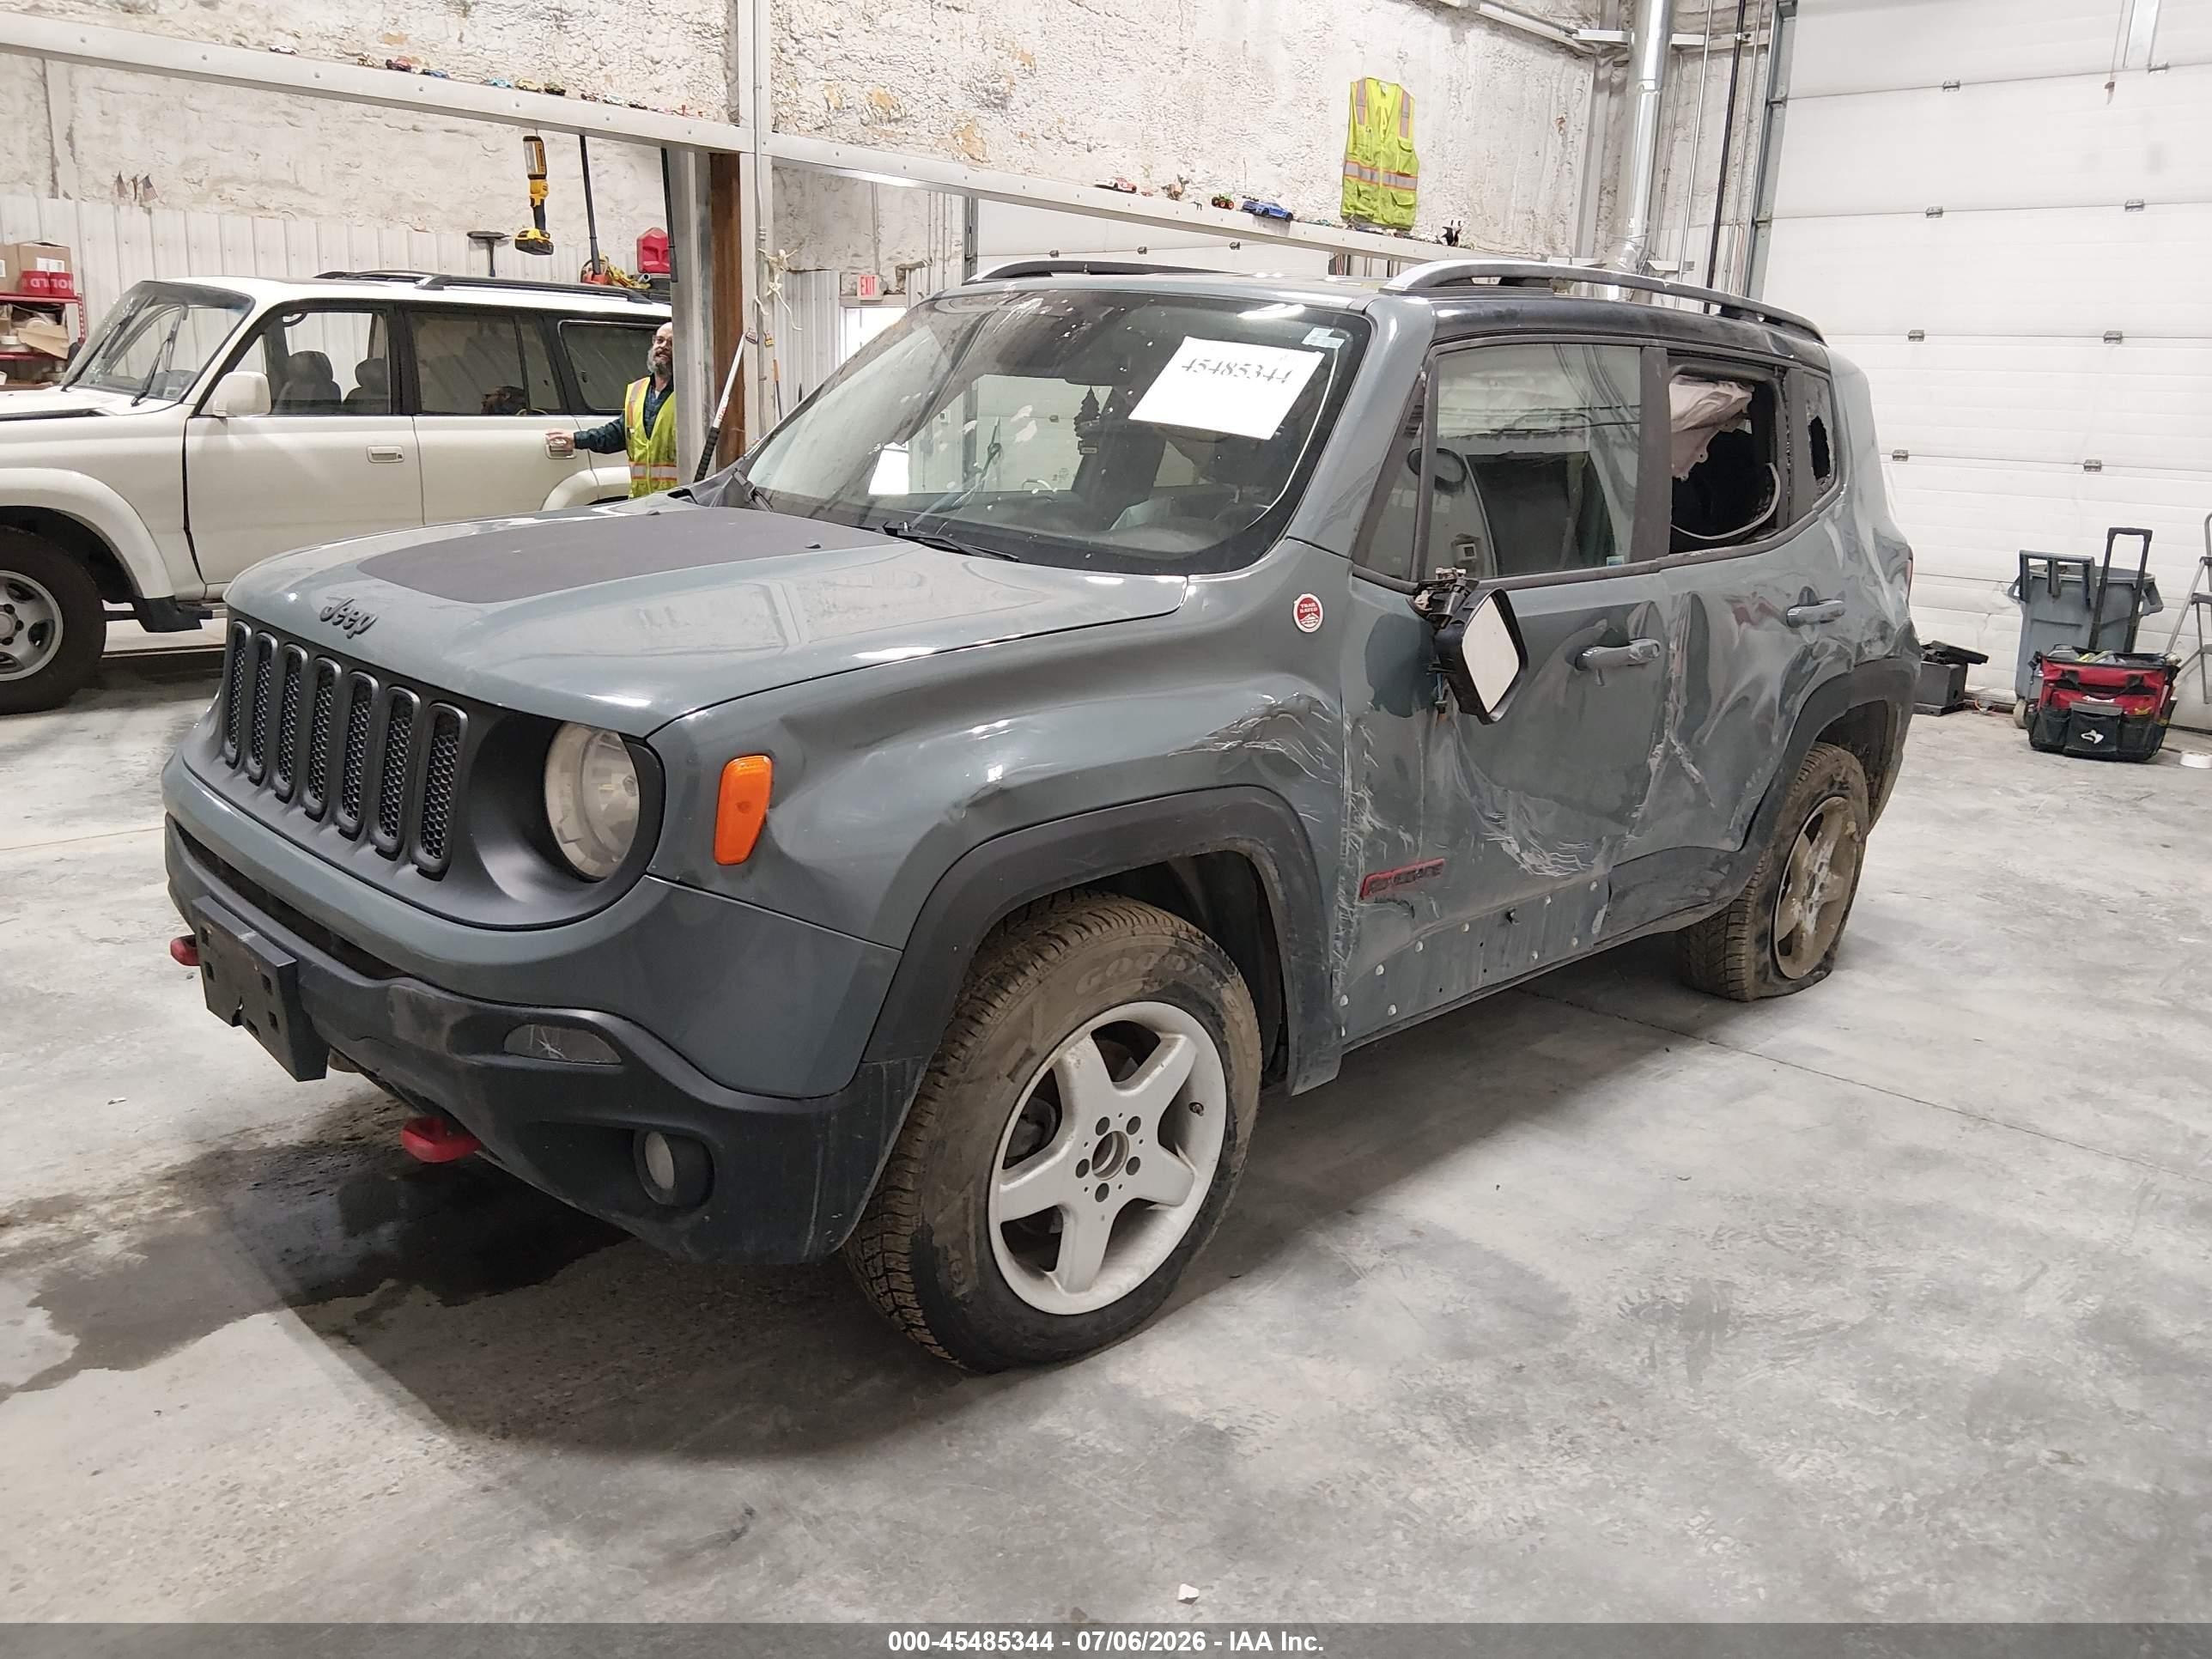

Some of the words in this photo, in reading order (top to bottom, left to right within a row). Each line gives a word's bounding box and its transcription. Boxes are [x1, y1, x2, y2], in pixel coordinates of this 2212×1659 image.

[860, 276, 876, 296] EXIT
[1182, 358, 1292, 383] 45485344
[319, 597, 379, 640] Jeep
